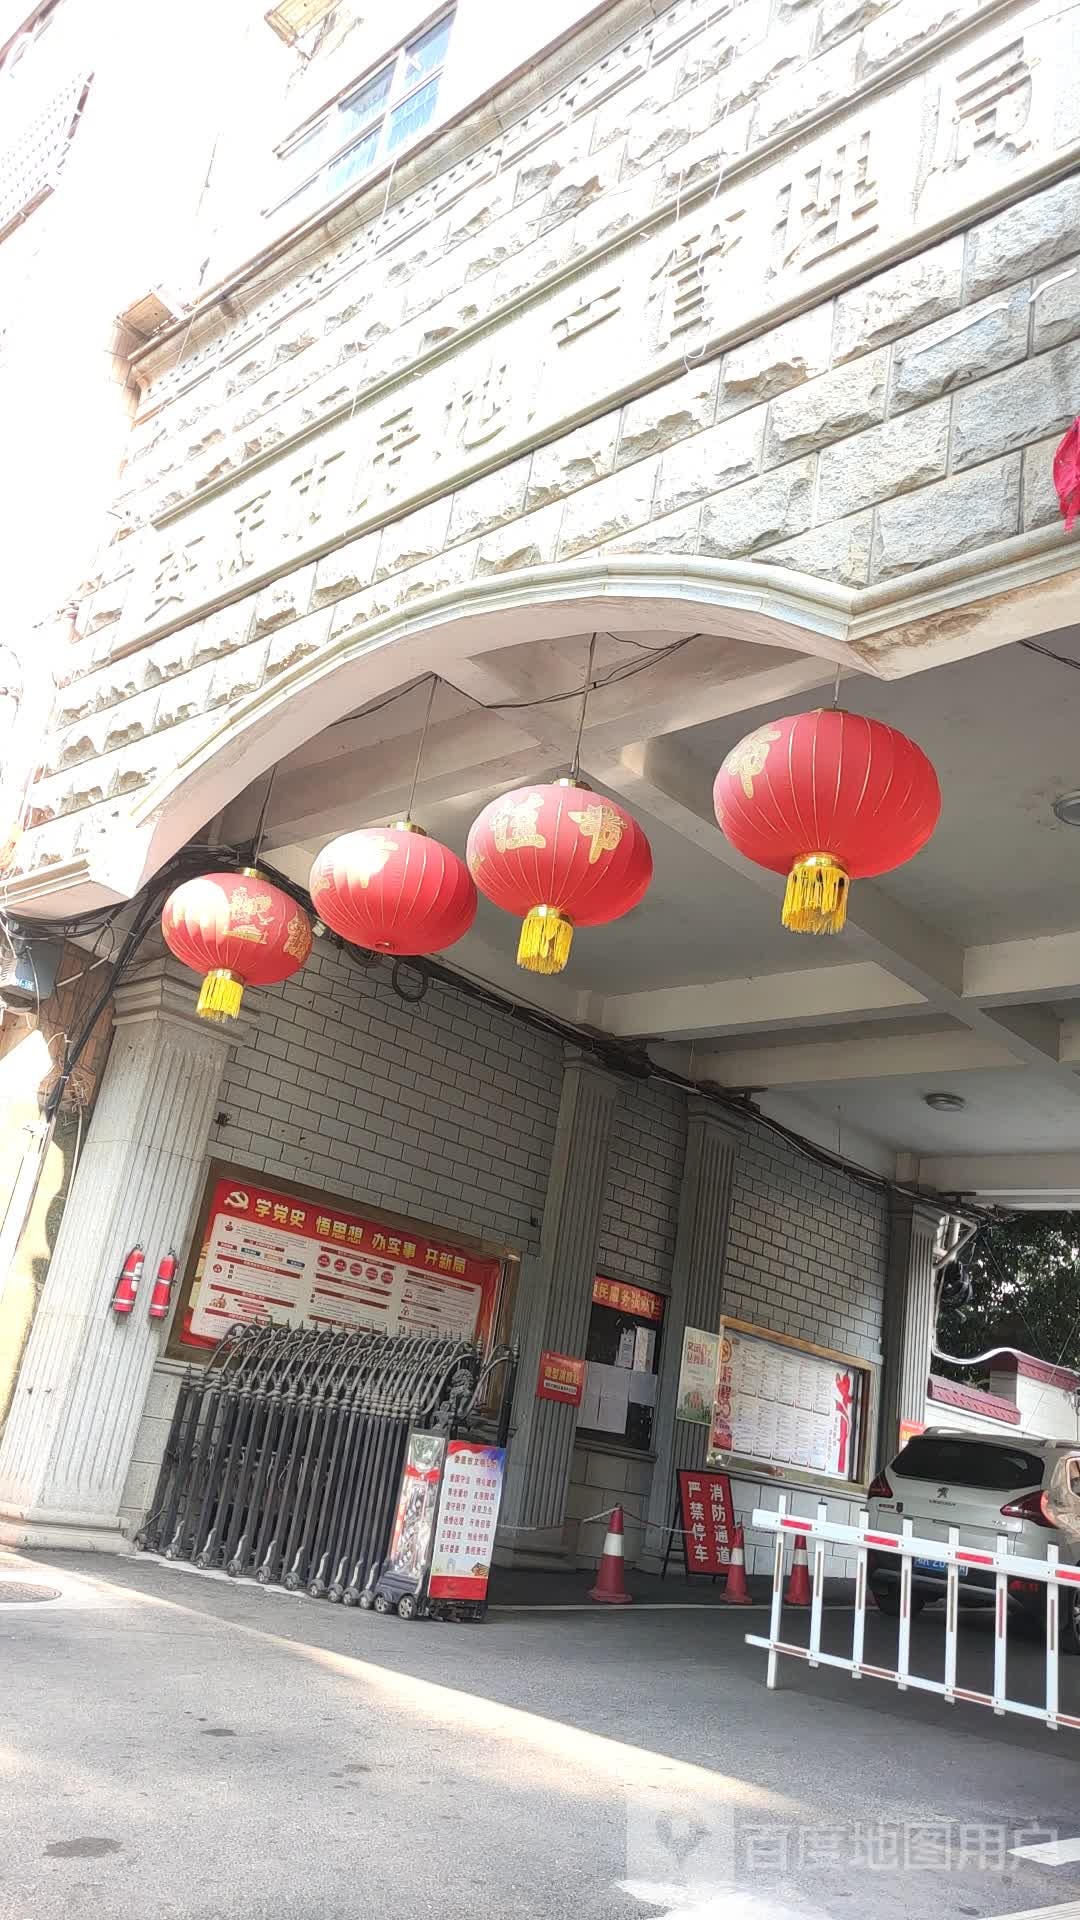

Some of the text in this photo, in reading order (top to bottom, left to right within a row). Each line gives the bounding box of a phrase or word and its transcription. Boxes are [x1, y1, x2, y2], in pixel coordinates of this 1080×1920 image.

[255, 1198, 467, 1275] 学党史 悟思想 办实事 开新局
[687, 1481, 709, 1563] 严禁停车
[710, 1483, 732, 1565] 消防通道
